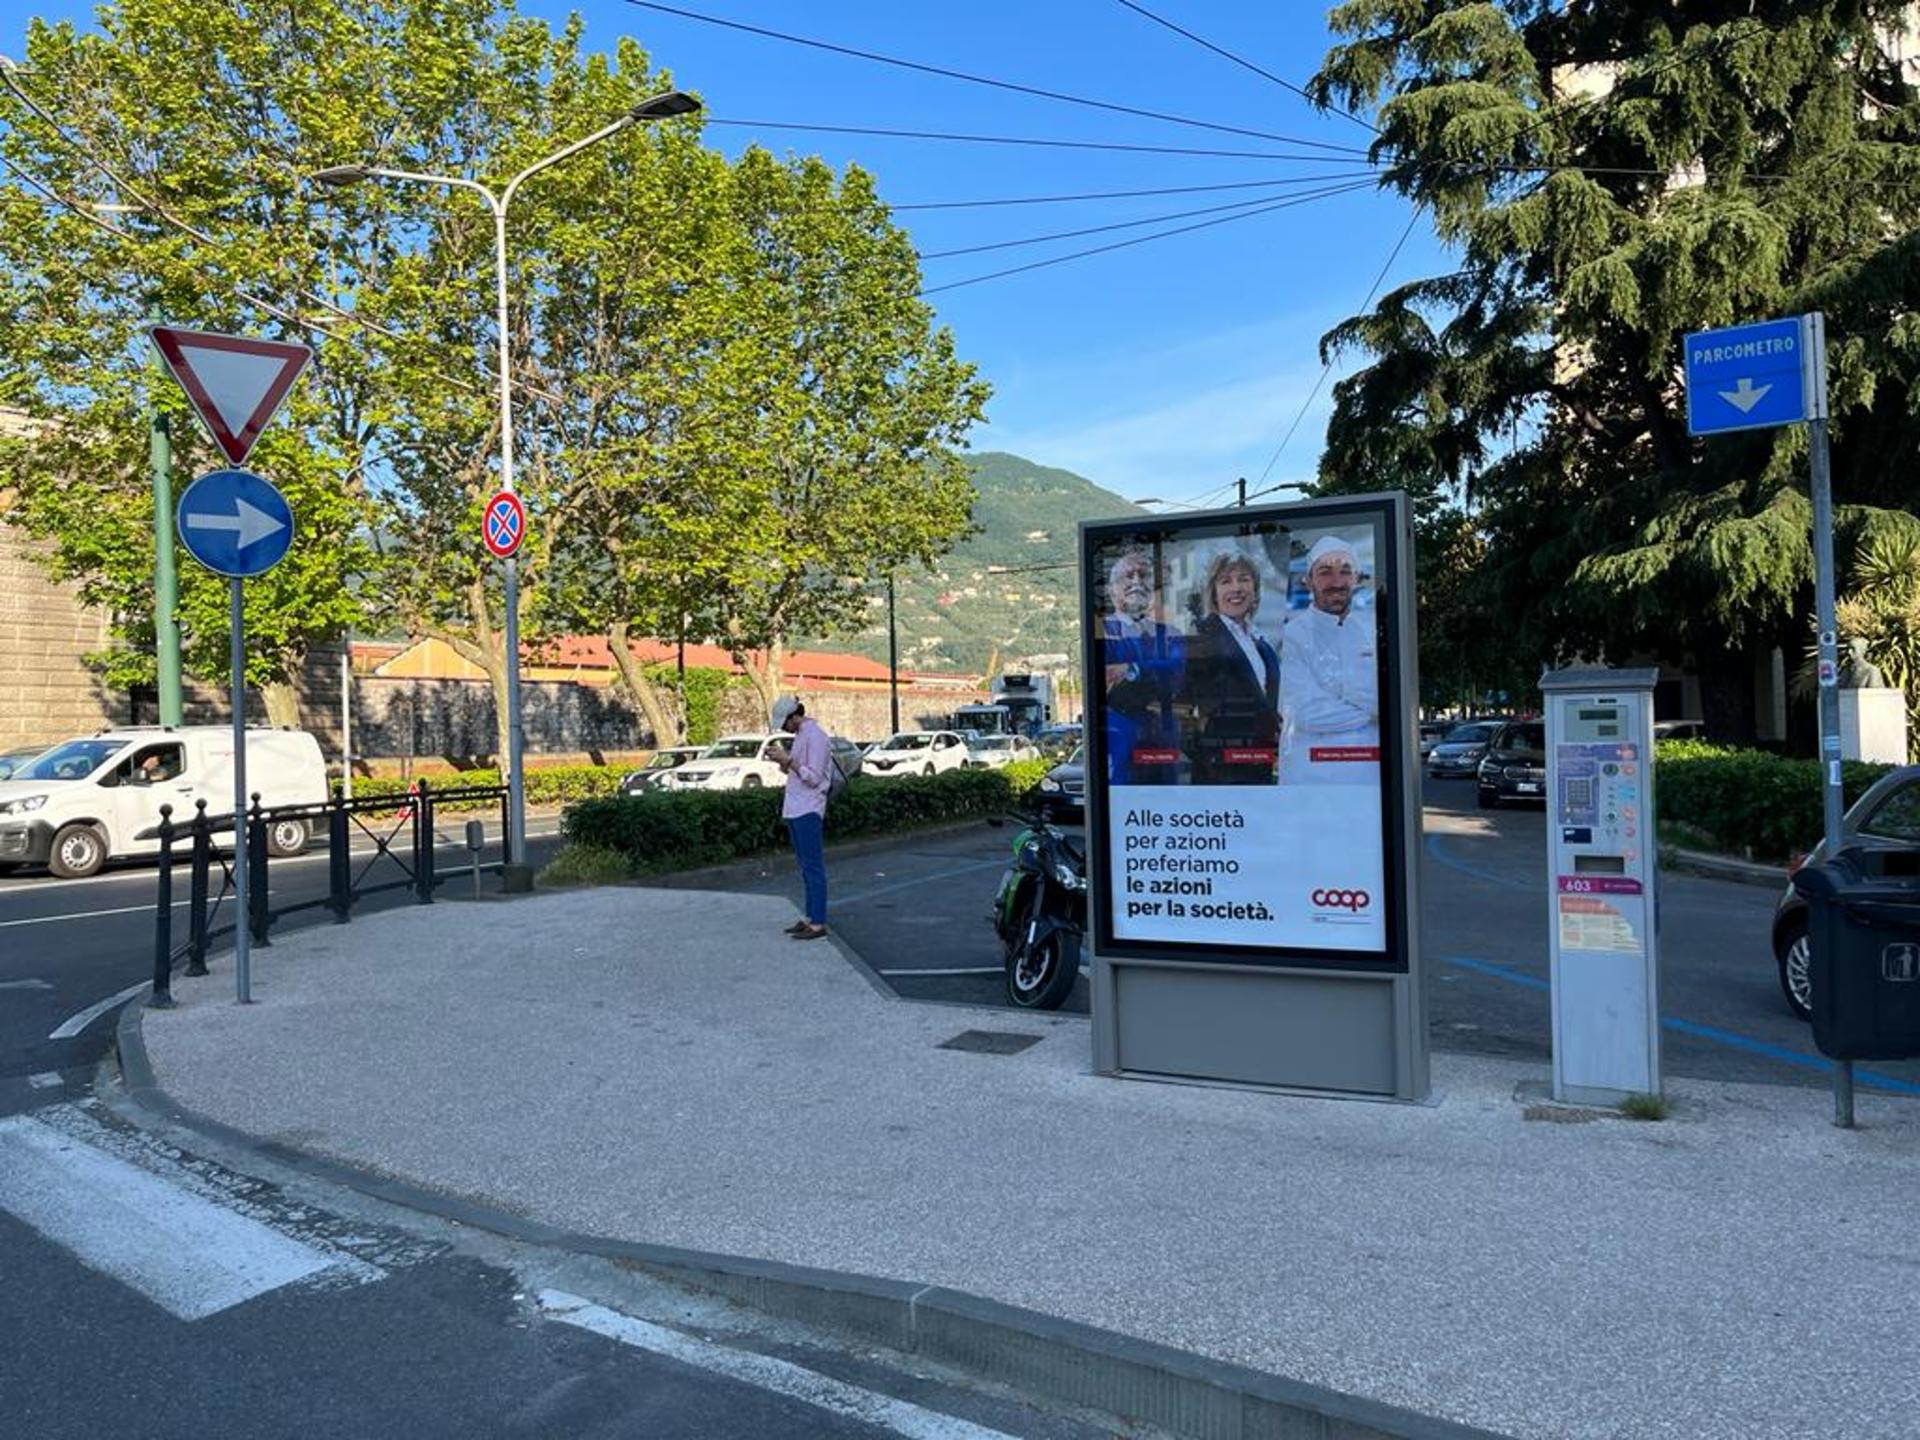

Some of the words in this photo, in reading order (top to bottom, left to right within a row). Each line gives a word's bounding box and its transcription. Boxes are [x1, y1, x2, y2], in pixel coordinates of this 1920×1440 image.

[1694, 337, 1794, 365] PARCOMETRO
[1124, 809, 1164, 827] Alle
[1169, 809, 1245, 828] società
[1126, 834, 1159, 852] per
[1165, 832, 1226, 850] azioni
[1126, 854, 1240, 874] preferiamo
[1126, 875, 1144, 893] le
[1150, 877, 1212, 895] azioni
[1565, 879, 1591, 892] 603
[1312, 888, 1370, 912] coop
[1127, 901, 1162, 918] per
[1167, 900, 1185, 917] la
[1190, 901, 1275, 921] società.
